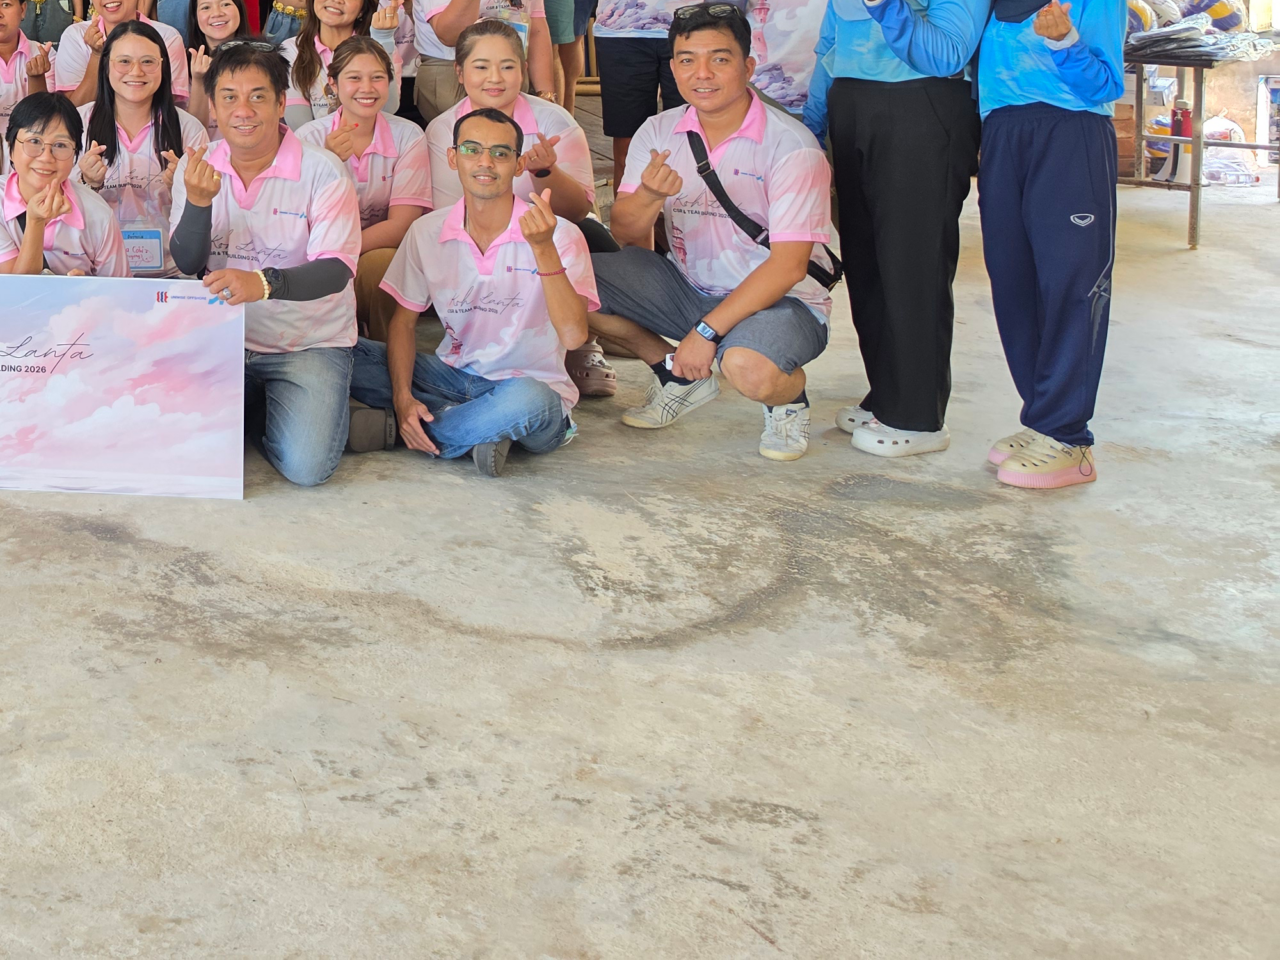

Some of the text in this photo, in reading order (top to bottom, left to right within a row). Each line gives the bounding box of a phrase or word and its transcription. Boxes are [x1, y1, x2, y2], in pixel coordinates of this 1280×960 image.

[673, 187, 706, 208] Koh
[449, 285, 524, 315] Koh Lanta
[24, 365, 47, 373] 2026
